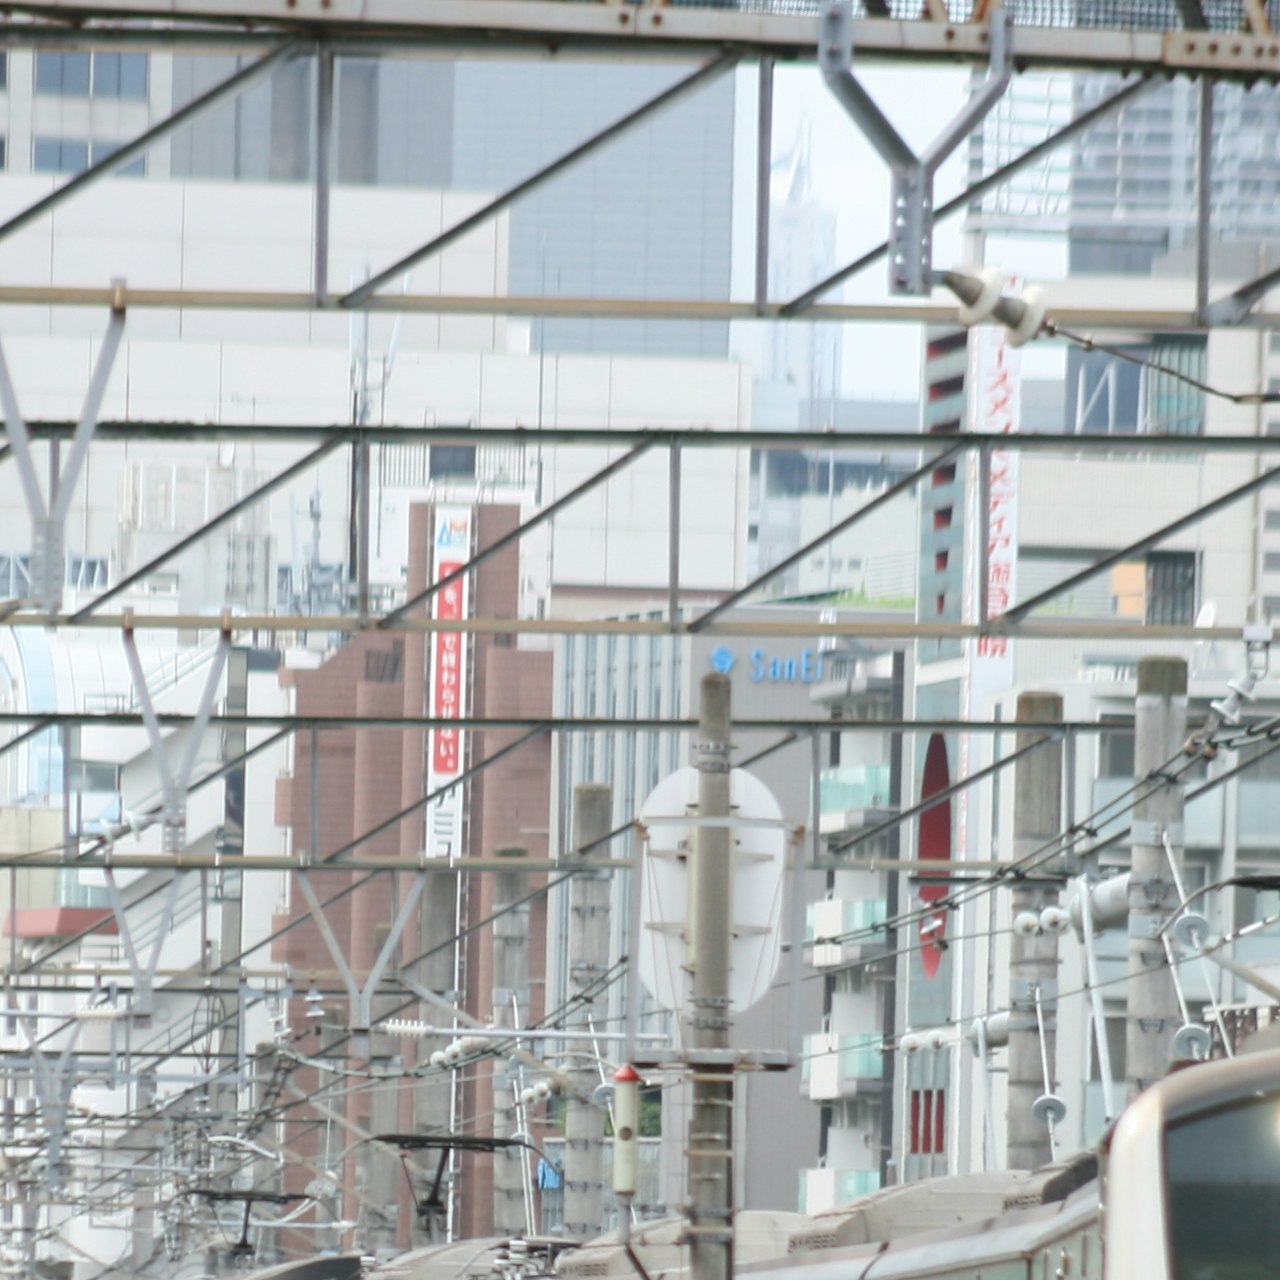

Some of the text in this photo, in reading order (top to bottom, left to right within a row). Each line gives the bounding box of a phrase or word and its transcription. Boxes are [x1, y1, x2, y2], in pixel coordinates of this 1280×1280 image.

[438, 566, 459, 769] を、で終わらせない。
